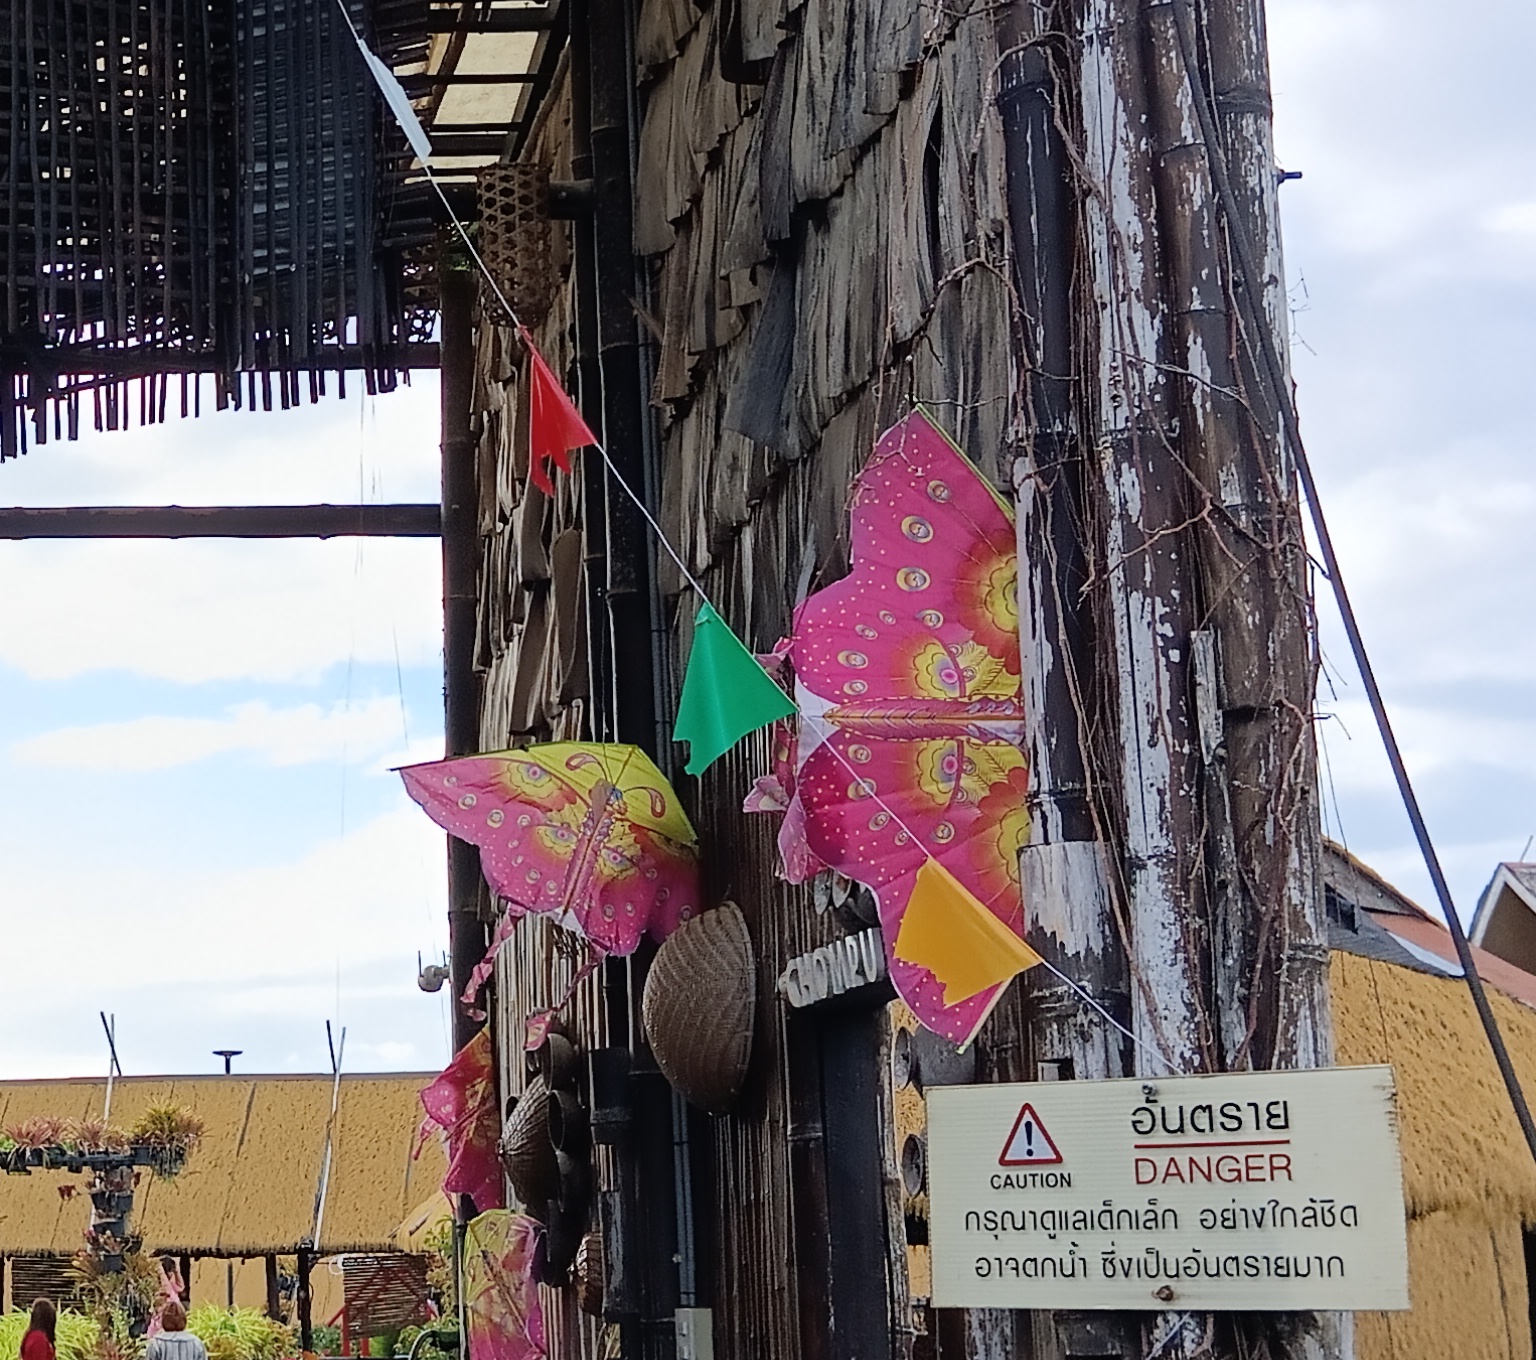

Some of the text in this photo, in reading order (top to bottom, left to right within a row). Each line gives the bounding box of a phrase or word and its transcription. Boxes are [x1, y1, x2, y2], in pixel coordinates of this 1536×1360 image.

[1131, 1095, 1290, 1135] อันตราย
[989, 1172, 1073, 1190] CAUTION
[1134, 1153, 1293, 1185] DANGER
[964, 1197, 1359, 1240] กรุณาดูแลเด็กเล็ก อย่างใกล้ชิด
[974, 1241, 1088, 1278] อาจตกน้ำ
